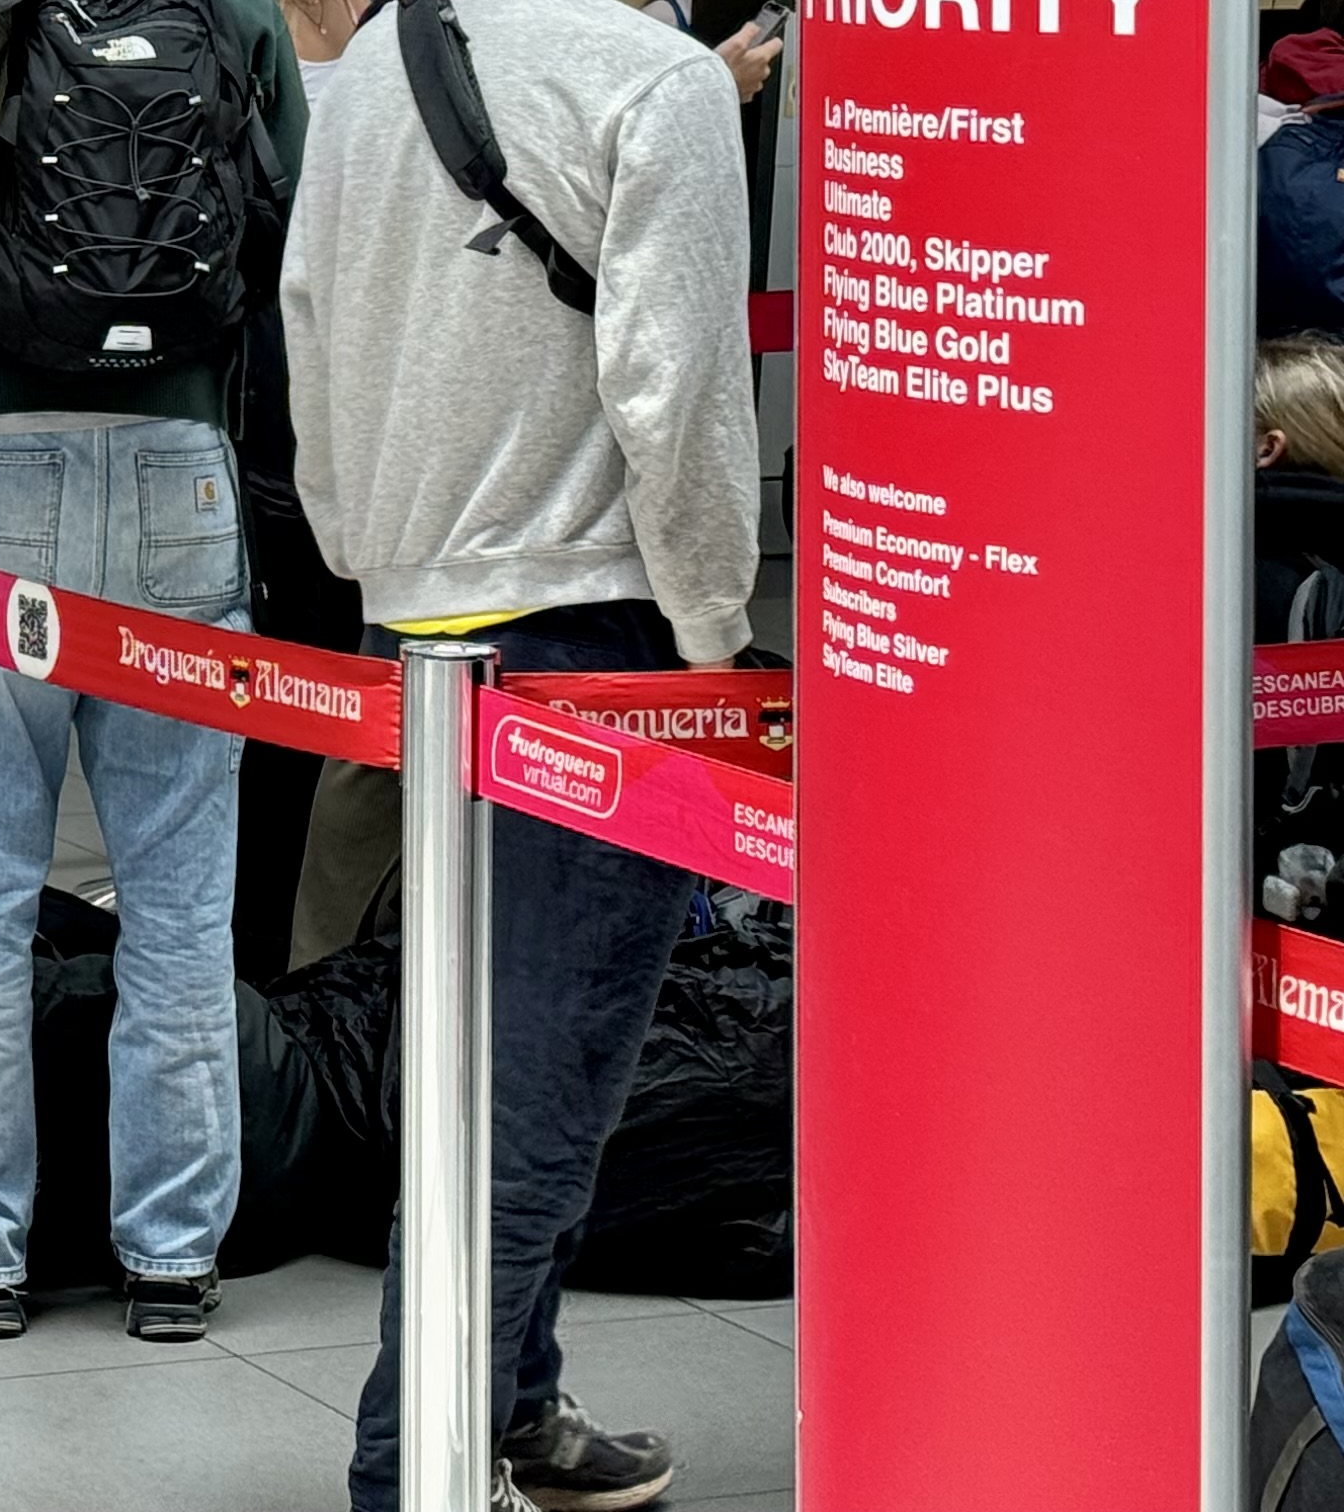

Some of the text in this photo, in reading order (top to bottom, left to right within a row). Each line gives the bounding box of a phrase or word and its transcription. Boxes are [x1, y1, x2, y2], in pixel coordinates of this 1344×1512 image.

[825, 96, 1025, 145] La Première/First
[825, 138, 904, 179] Business
[824, 180, 892, 221] Ultimate
[824, 222, 1049, 284] Club 2000, Skipper
[824, 265, 1085, 326] Flying Blue Platinum
[824, 307, 1010, 365] Flying Blue Gold
[823, 349, 1053, 413] SkyTeam Elite Plus
[823, 464, 947, 516] We also welcome
[823, 510, 873, 548] Premium
[876, 526, 963, 571] Economy
[985, 545, 1039, 575] Flex
[823, 543, 951, 598] Premium Comfort
[823, 576, 897, 622] Subscribers
[823, 610, 949, 666] Flying Blue Silver
[255, 659, 362, 722] Alemana
[823, 643, 914, 694] SkyTeam Elite
[1253, 695, 1344, 720] DESCUBR
[734, 802, 793, 840] ESCANE
[734, 831, 793, 870] DESCU
[1252, 952, 1344, 1034] Alema
